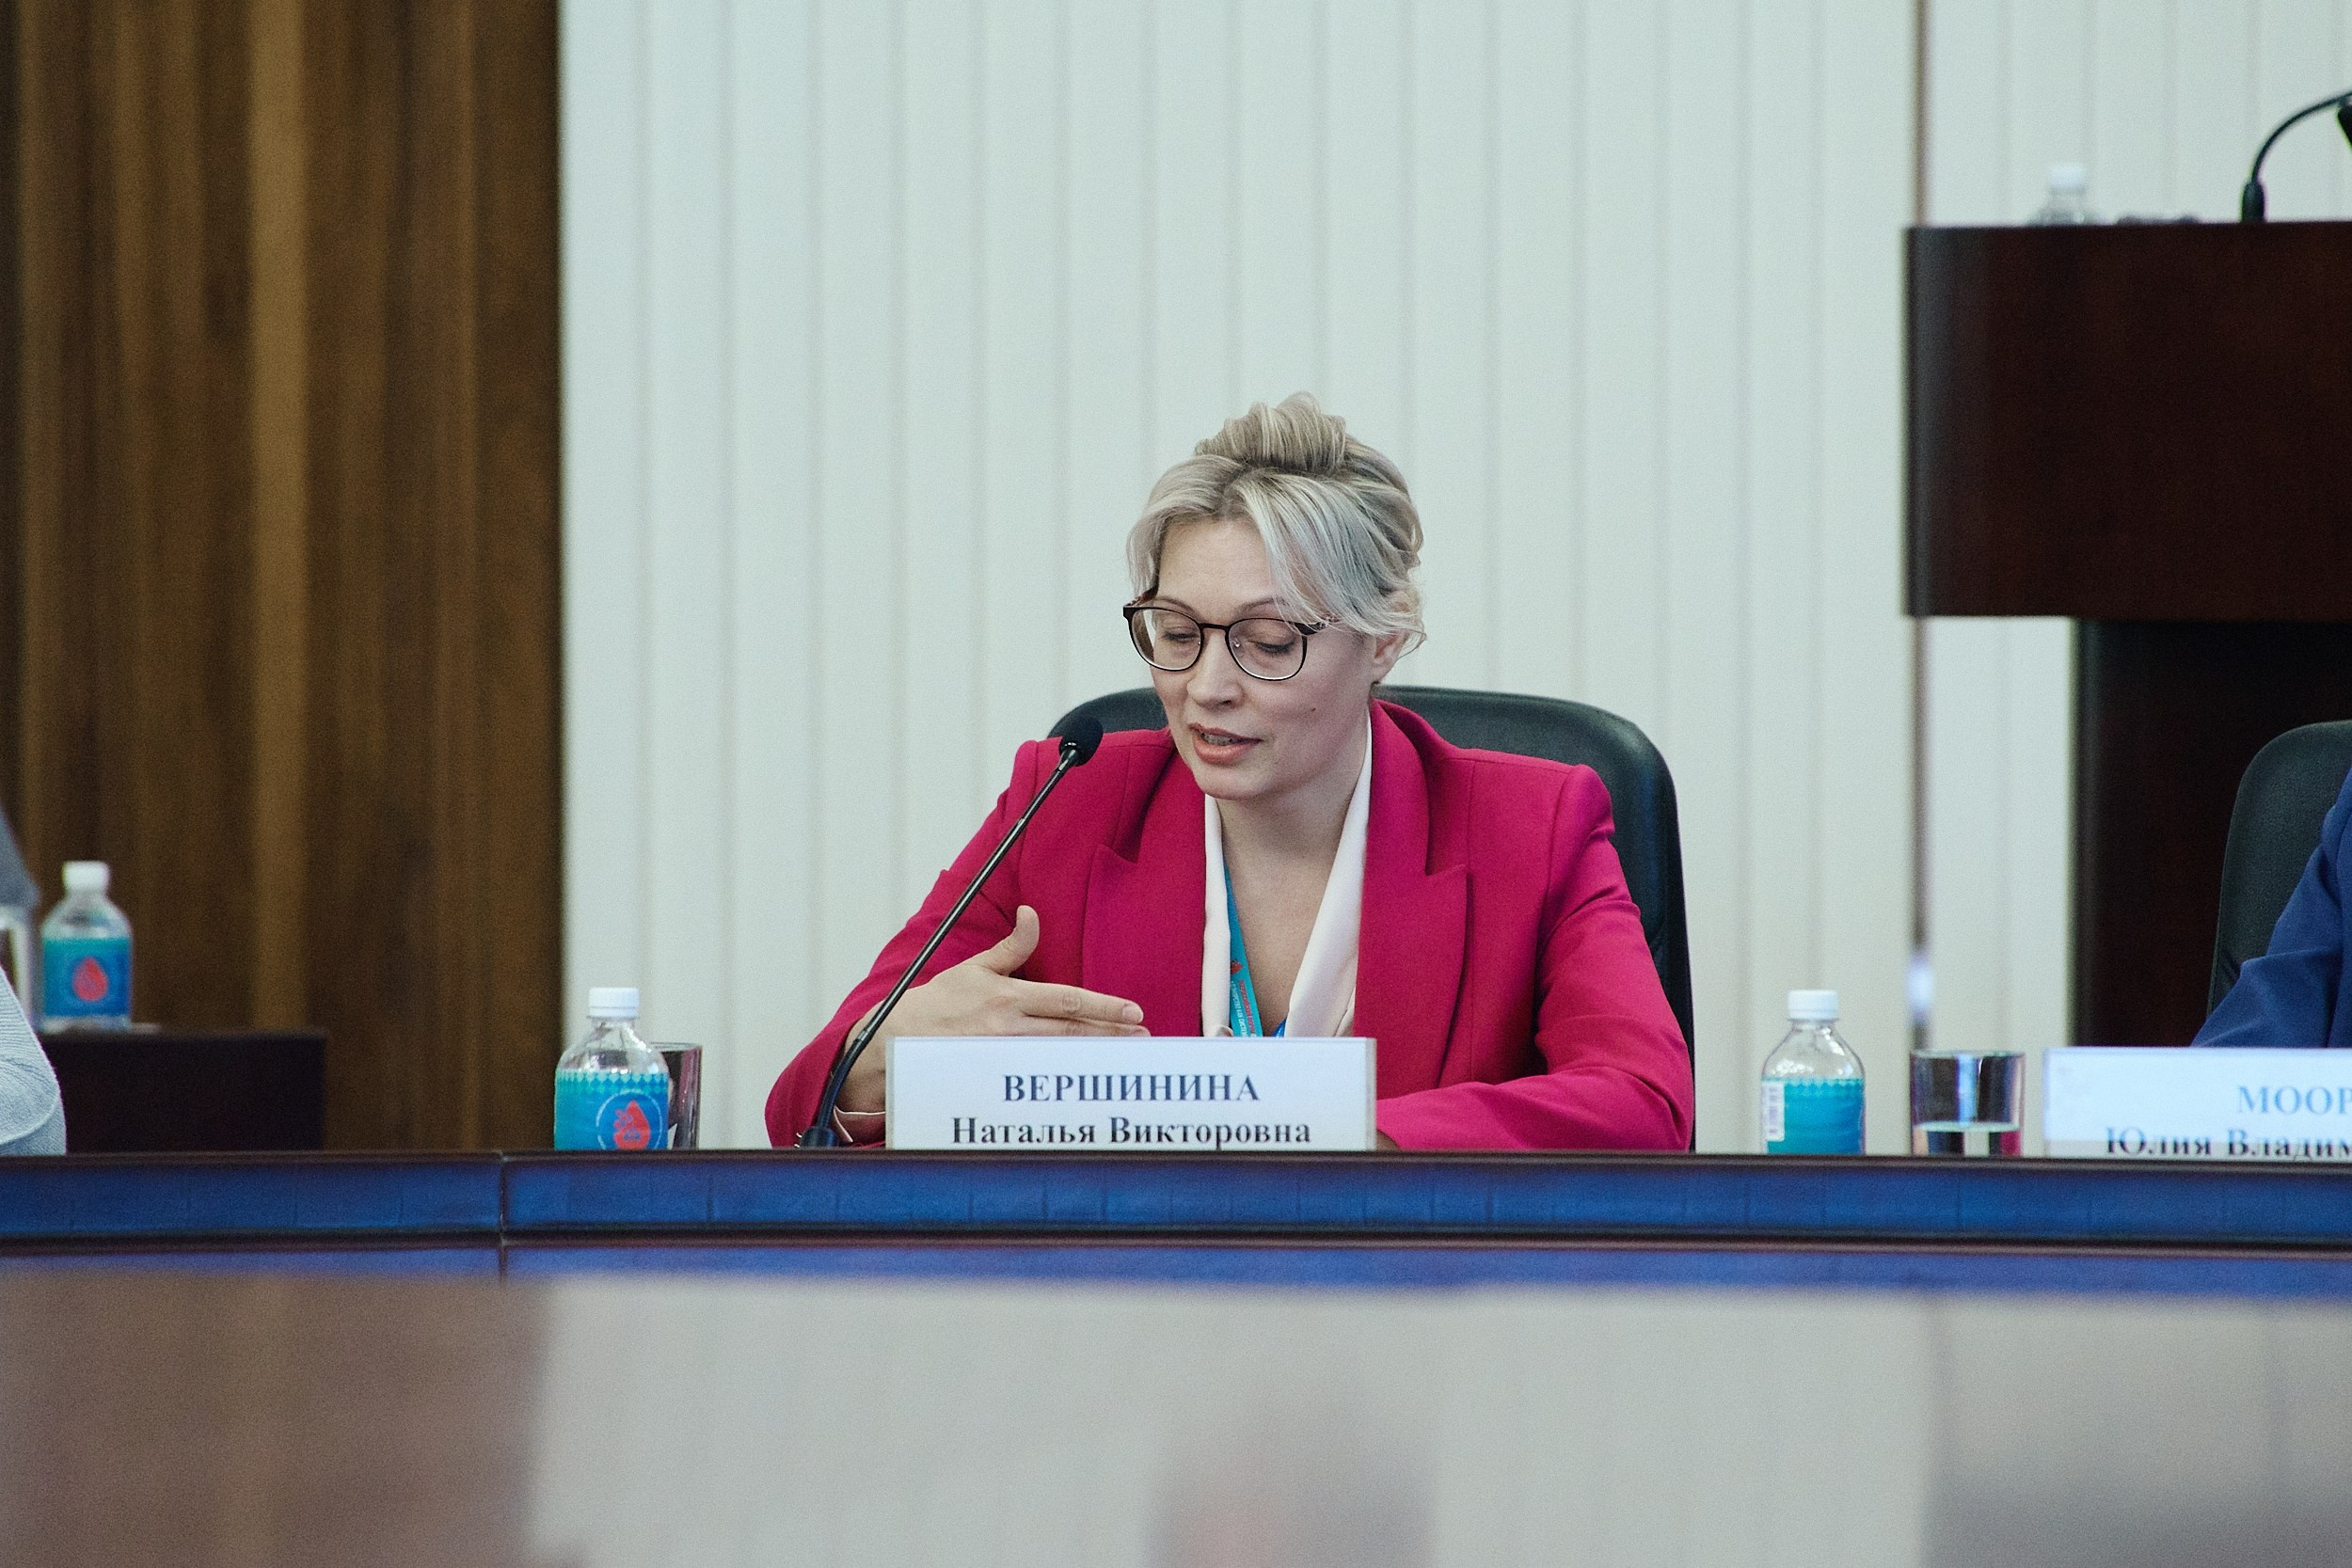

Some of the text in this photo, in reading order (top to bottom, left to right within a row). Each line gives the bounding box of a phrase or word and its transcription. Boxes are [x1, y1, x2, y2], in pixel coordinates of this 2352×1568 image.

[1003, 1074, 1261, 1101] ВЕРШИНИНА
[2237, 1085, 2352, 1115] МООР
[951, 1116, 1311, 1150] Наталья Викторовна
[2106, 1127, 2212, 1155] Юлия
